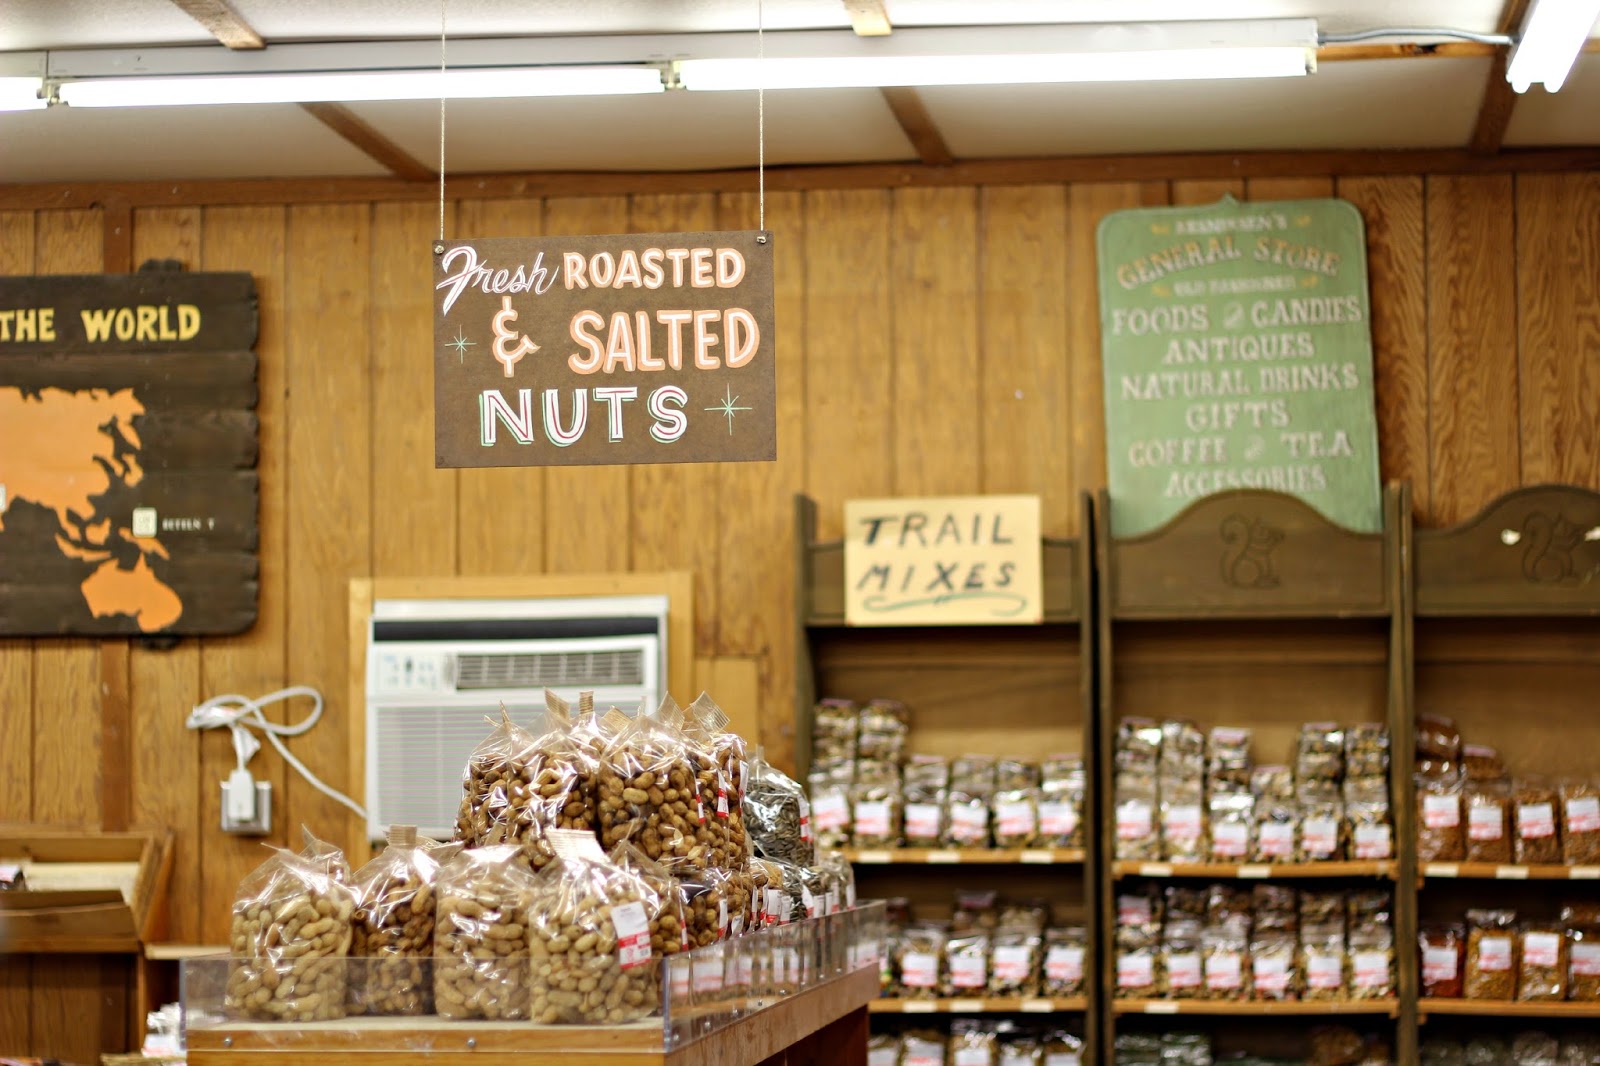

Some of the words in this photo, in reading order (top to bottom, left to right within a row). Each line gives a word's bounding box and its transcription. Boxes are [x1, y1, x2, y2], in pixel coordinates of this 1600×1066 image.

[436, 245, 560, 317] Fresh
[563, 247, 746, 290] ROASTED
[1116, 236, 1243, 290] GENERAL
[1253, 236, 1342, 277] STORE
[0, 308, 56, 342] THE
[81, 304, 202, 342] WORLD
[1112, 304, 1209, 336] FOODS
[1251, 296, 1363, 328] CANDIES
[491, 295, 541, 378] &
[567, 307, 760, 375] SALTED
[1162, 331, 1316, 365] ANTIQUES
[1120, 369, 1250, 400] NATURAL
[1259, 362, 1361, 393] DRINKS
[478, 385, 688, 447] NUTS
[1185, 398, 1290, 432] GIFTS
[1128, 435, 1227, 468] COFFEE
[1281, 429, 1355, 459] TEA
[1164, 464, 1328, 498] ACCESSORIES
[858, 510, 1015, 548] TRAIL
[855, 561, 1016, 593] MIXES
